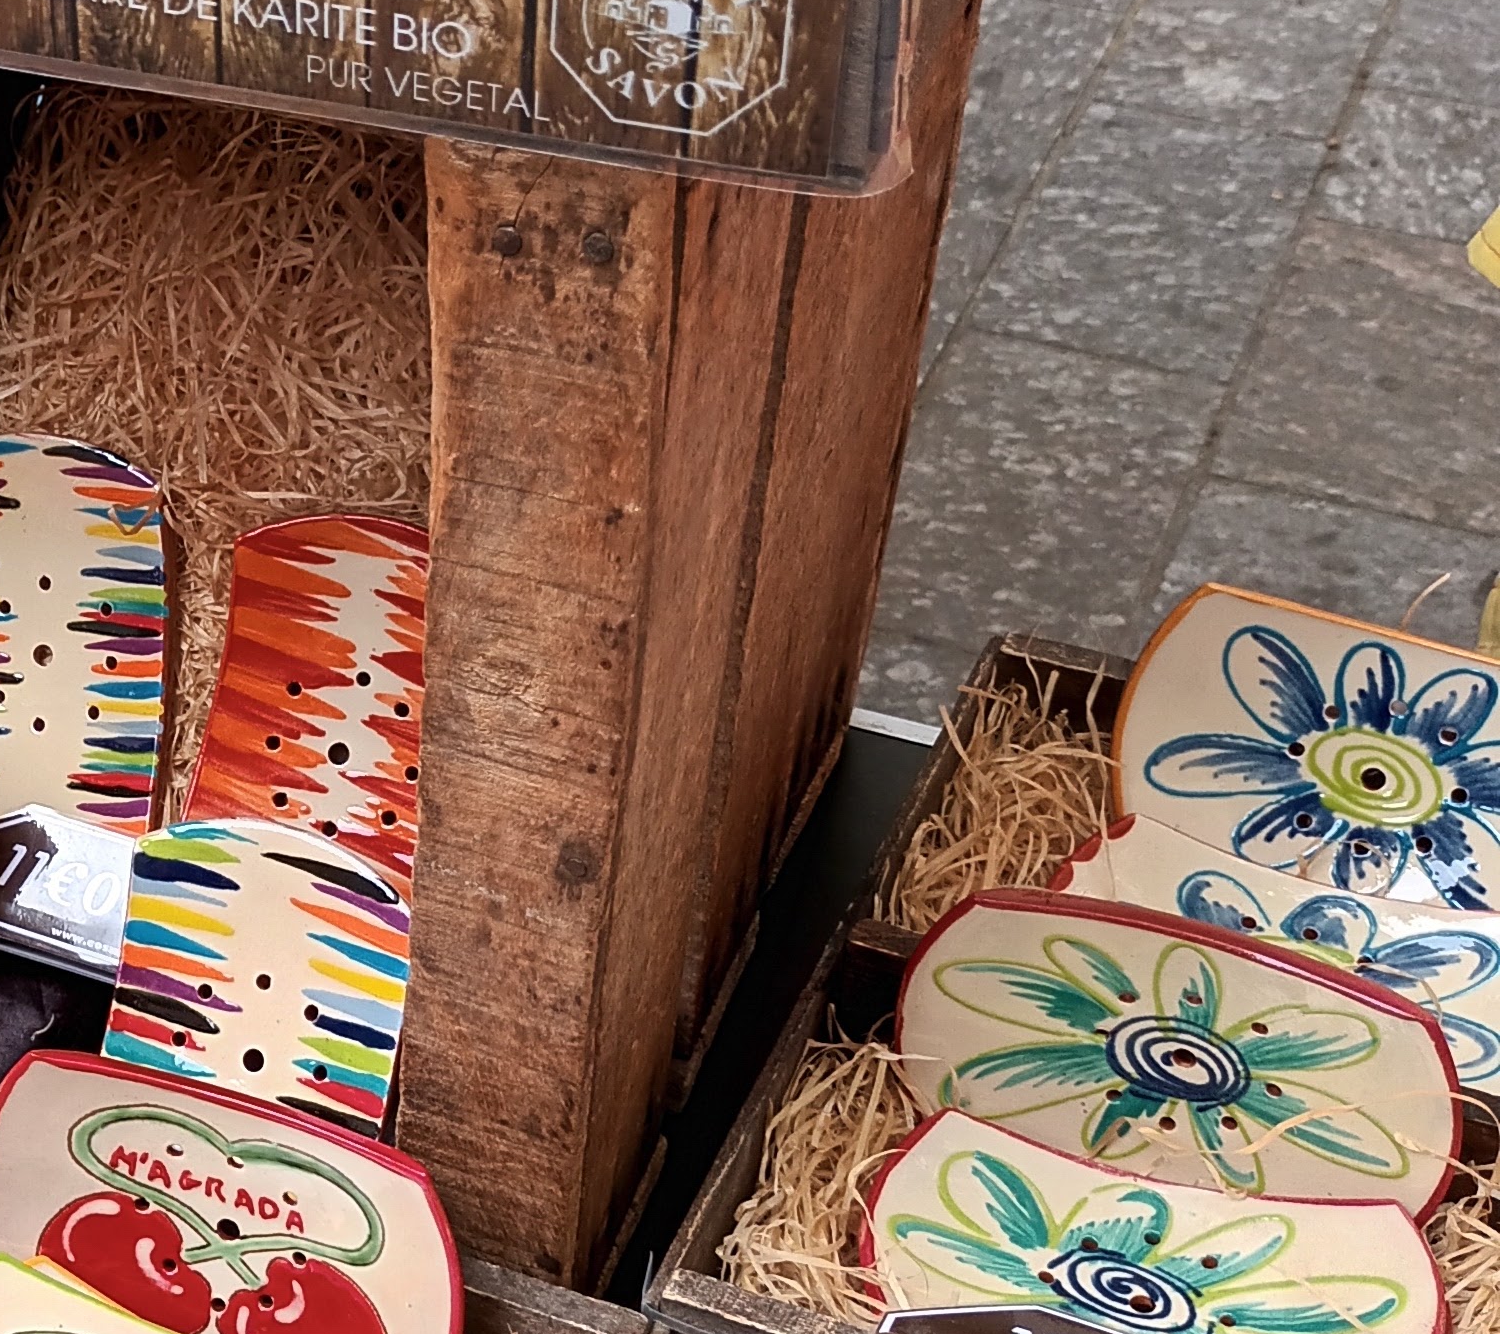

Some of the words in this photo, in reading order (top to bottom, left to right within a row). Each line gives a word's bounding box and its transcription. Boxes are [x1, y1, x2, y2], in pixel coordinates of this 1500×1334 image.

[393, 12, 472, 60] BIO
[306, 53, 373, 94] PUR
[385, 66, 551, 123] VEGETAL
[585, 46, 745, 110] SAVON
[108, 1144, 306, 1234] M'AGRADA
